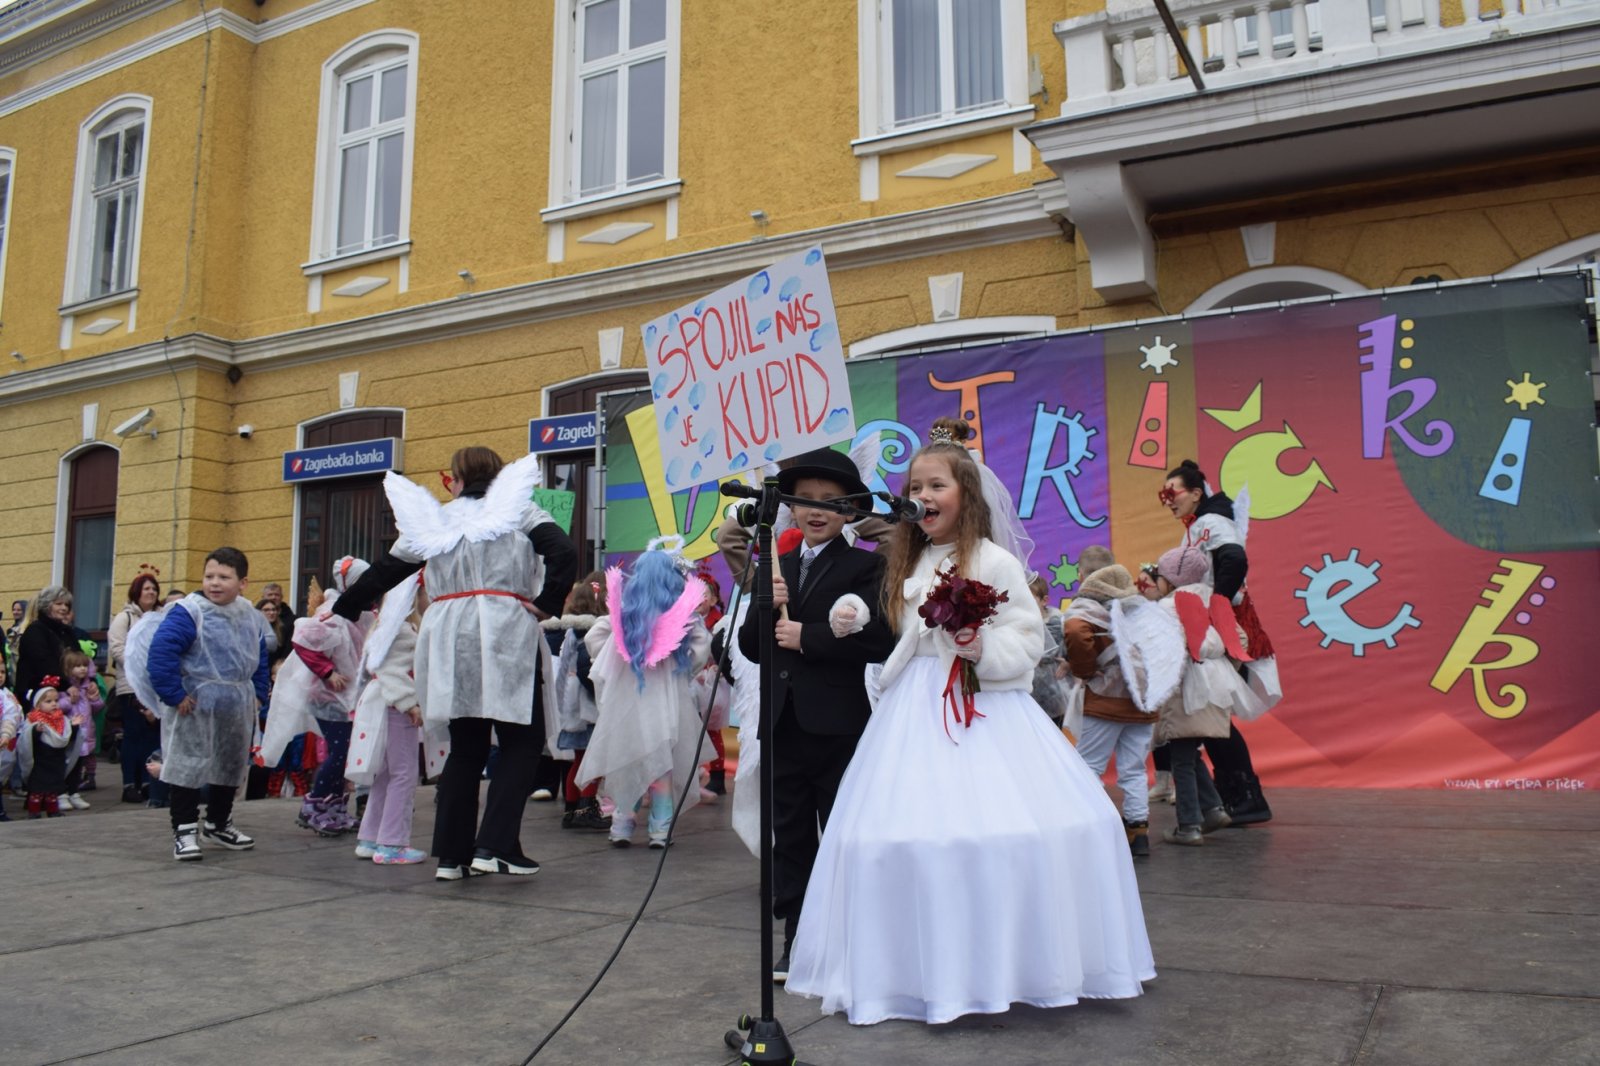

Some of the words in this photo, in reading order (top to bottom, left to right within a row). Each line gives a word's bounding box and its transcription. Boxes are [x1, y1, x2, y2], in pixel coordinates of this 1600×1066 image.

[657, 295, 765, 399] SPOJIL
[775, 293, 821, 343] NAS
[680, 415, 698, 447] JE
[718, 353, 830, 460] KUPID
[557, 421, 606, 443] Zagreb
[304, 452, 354, 473] Zagrebačka
[355, 448, 384, 465] banka
[1505, 779, 1542, 790] PETRA
